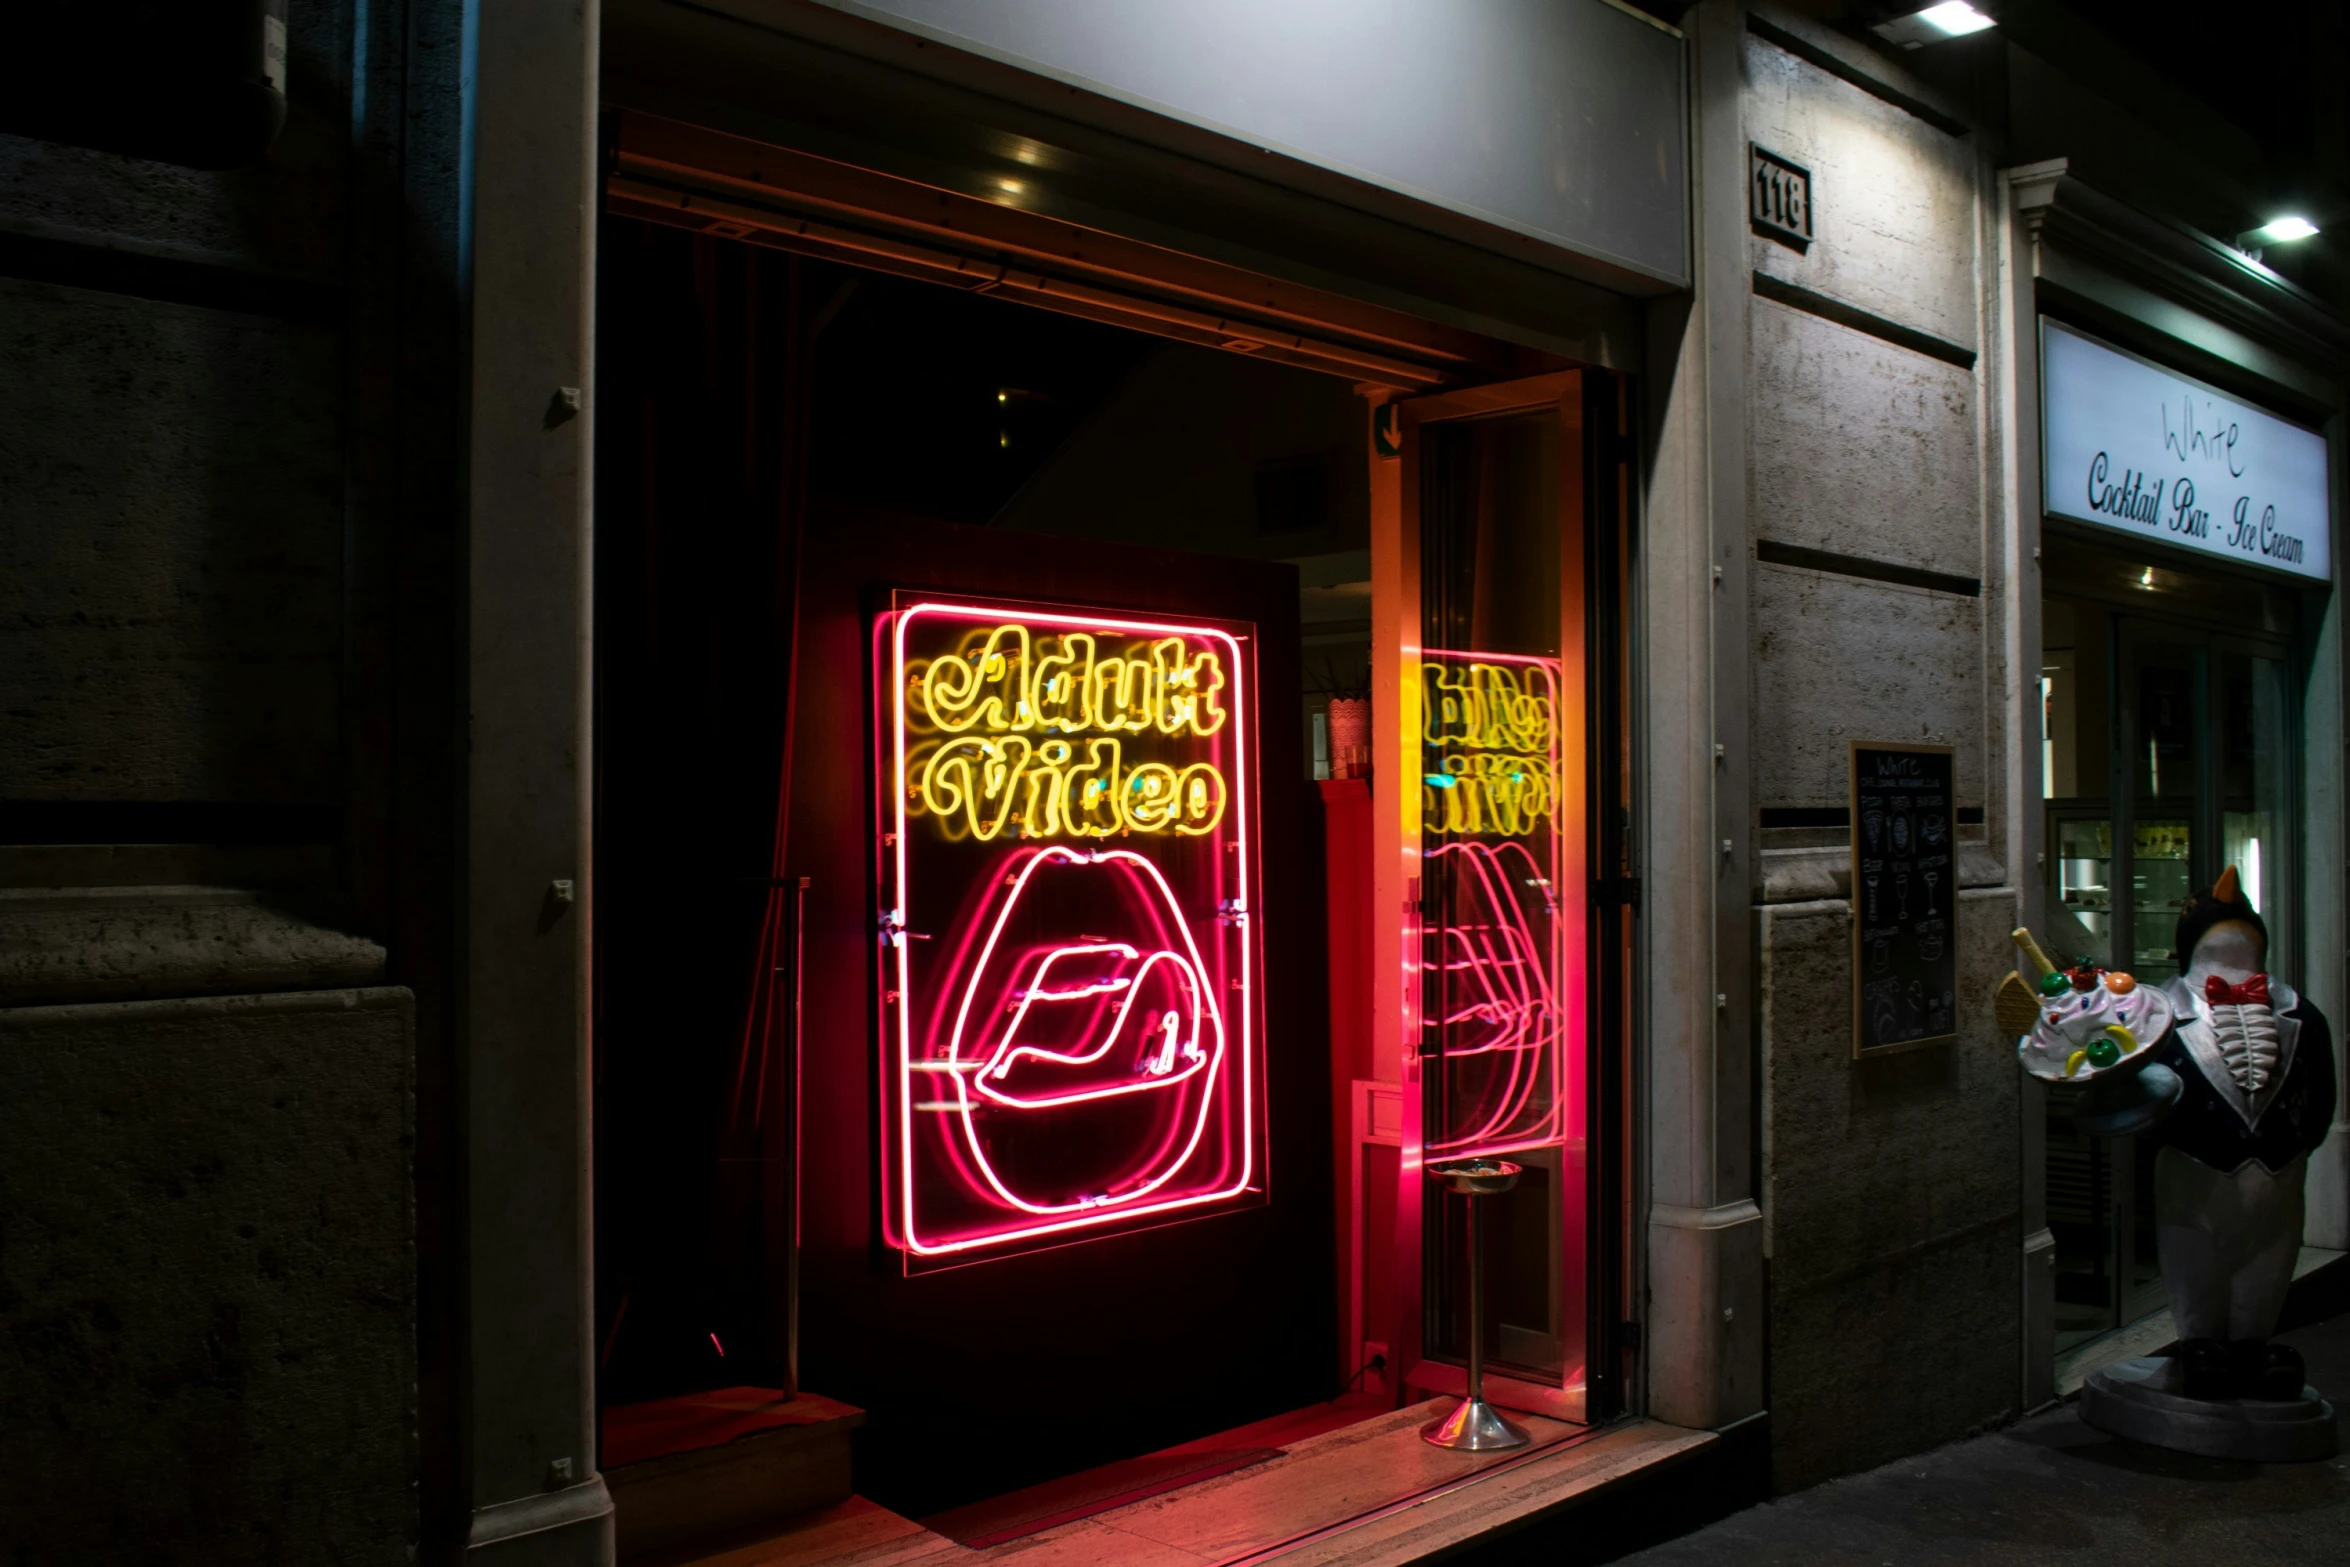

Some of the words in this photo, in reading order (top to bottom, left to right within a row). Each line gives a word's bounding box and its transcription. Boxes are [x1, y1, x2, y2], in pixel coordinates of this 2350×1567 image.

[1756, 161, 1803, 229] 118
[2088, 451, 2164, 526] Cocktail
[2169, 477, 2210, 539] Bar
[2227, 496, 2257, 552] Ice
[2260, 504, 2304, 564] Cream
[923, 624, 1226, 736] Adult
[922, 735, 1227, 842] Video
